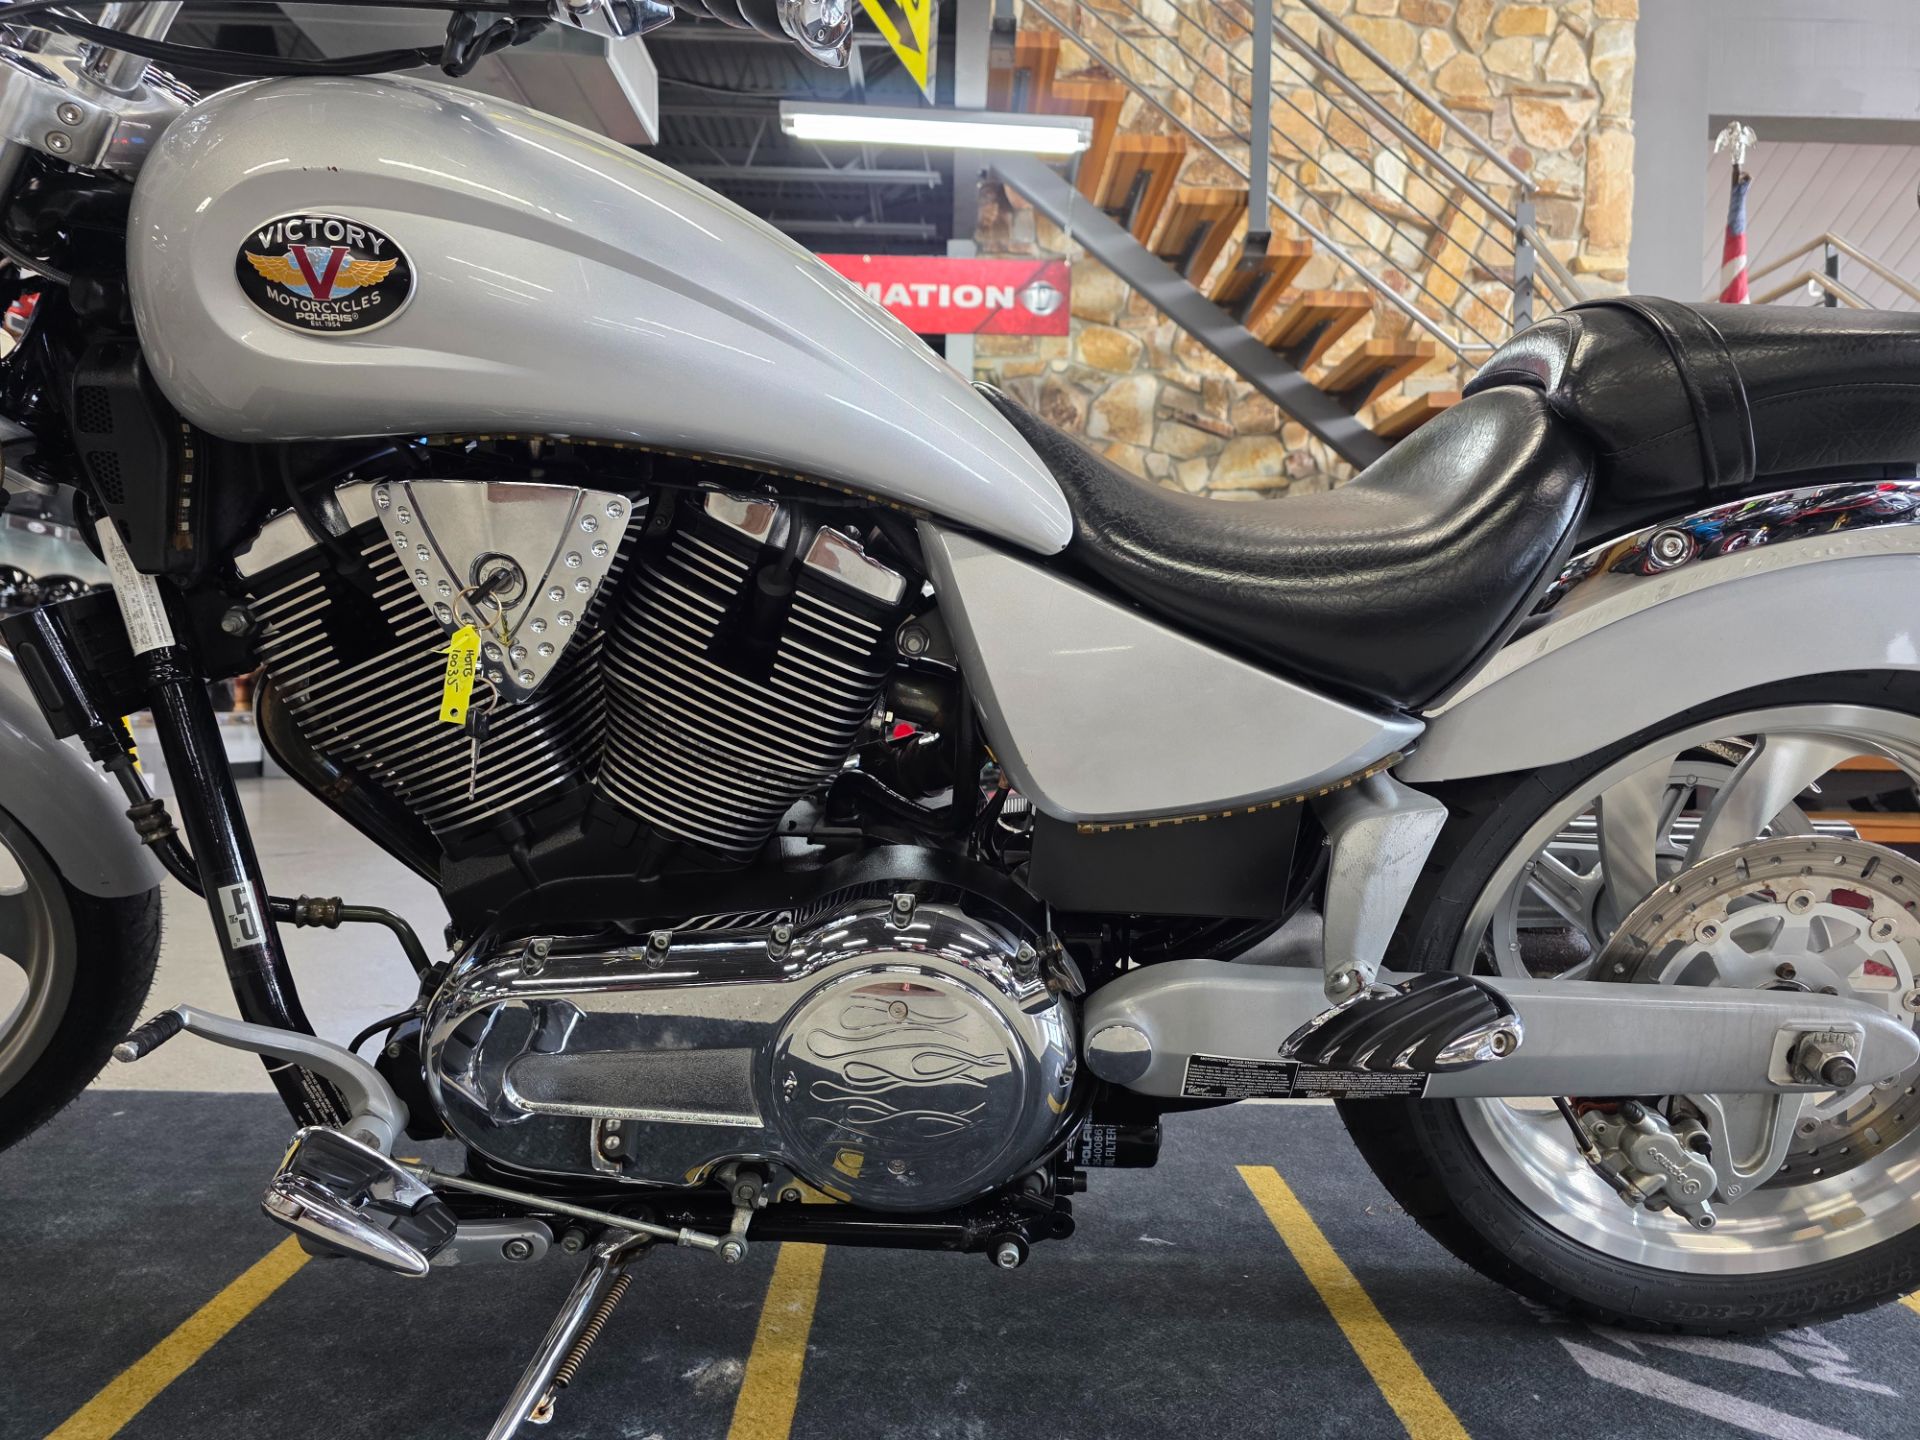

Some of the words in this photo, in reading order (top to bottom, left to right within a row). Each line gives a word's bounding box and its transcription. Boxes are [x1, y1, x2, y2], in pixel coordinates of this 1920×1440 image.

[258, 219, 385, 256] VICTORY
[266, 285, 382, 314] MOTORCYCLES
[1104, 1128, 1117, 1157] FILTER
